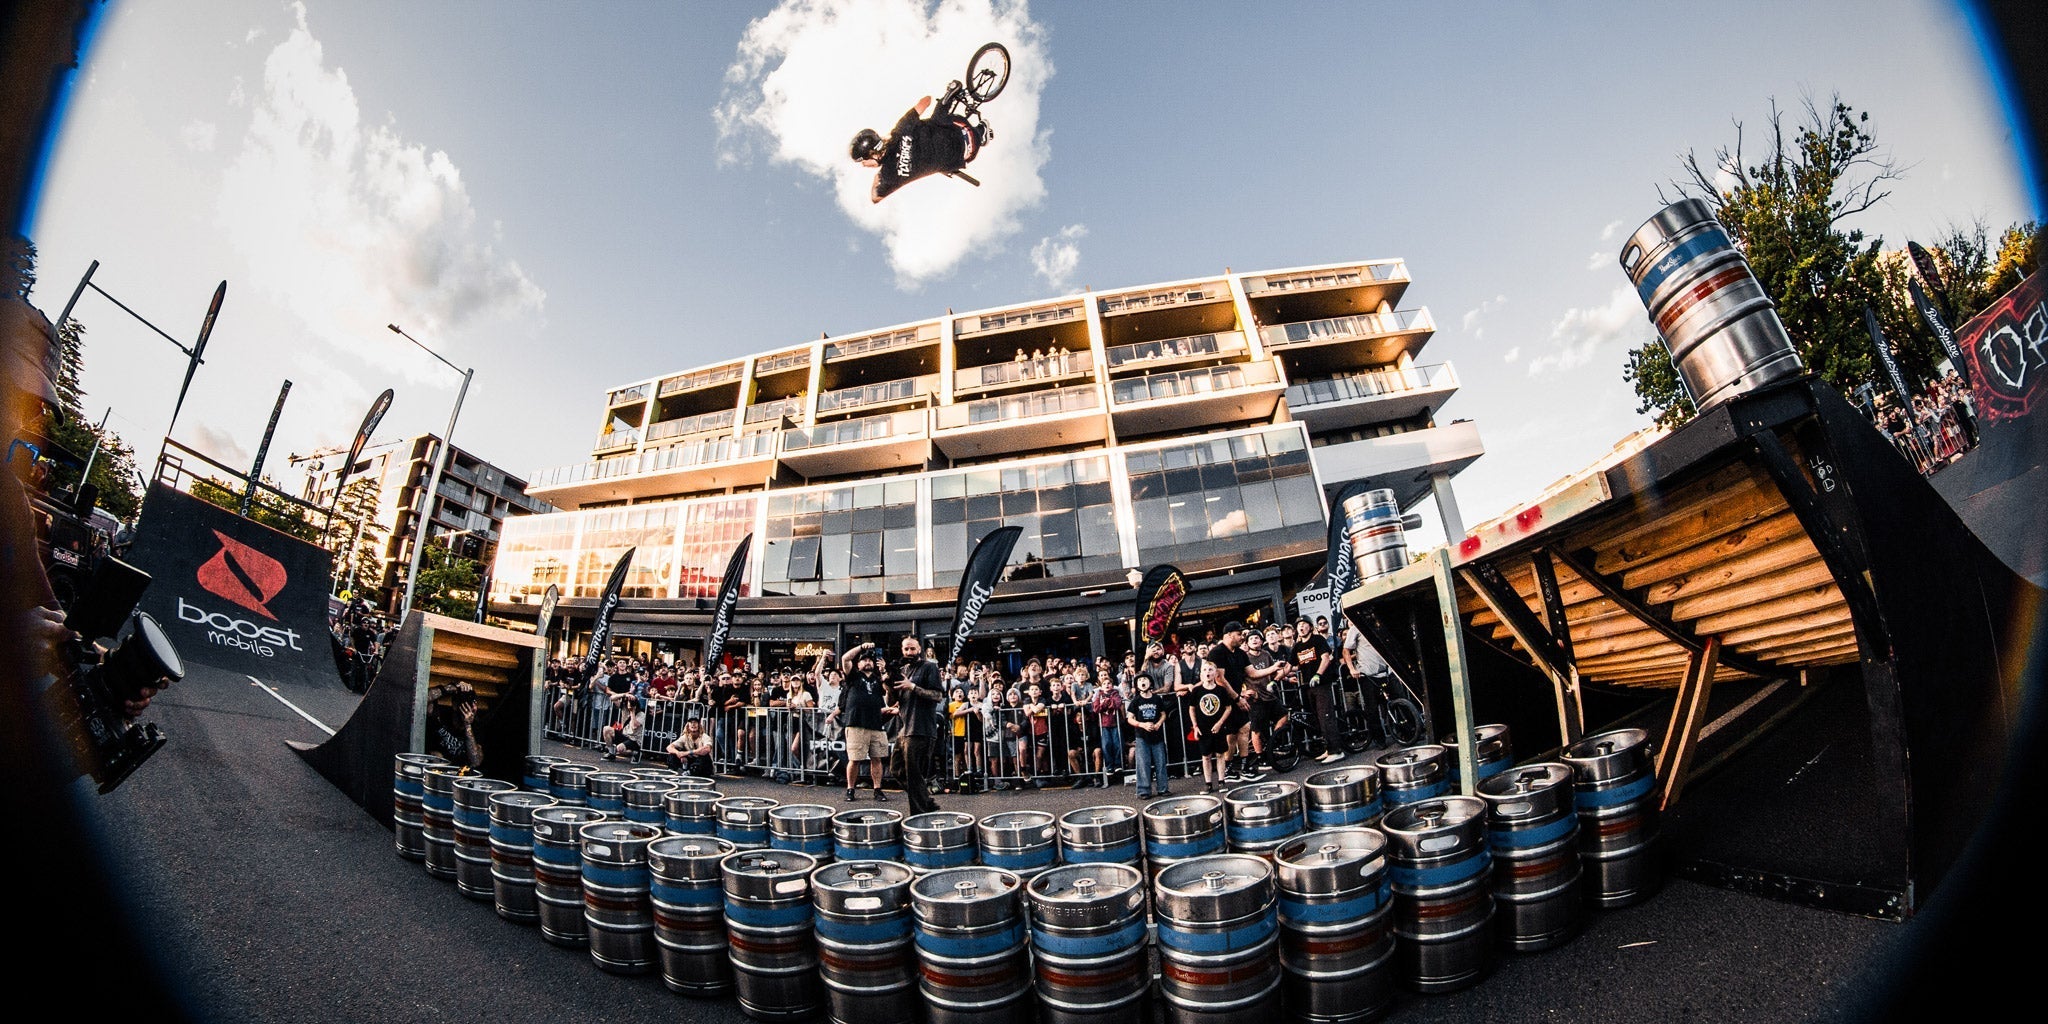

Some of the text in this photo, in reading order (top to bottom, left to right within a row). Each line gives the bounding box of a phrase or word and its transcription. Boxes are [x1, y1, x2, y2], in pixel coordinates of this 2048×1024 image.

[1923, 307, 1960, 358] BentSpoke
[1302, 592, 1330, 604] FOOD
[179, 597, 303, 651] boost
[208, 631, 274, 657] mobile
